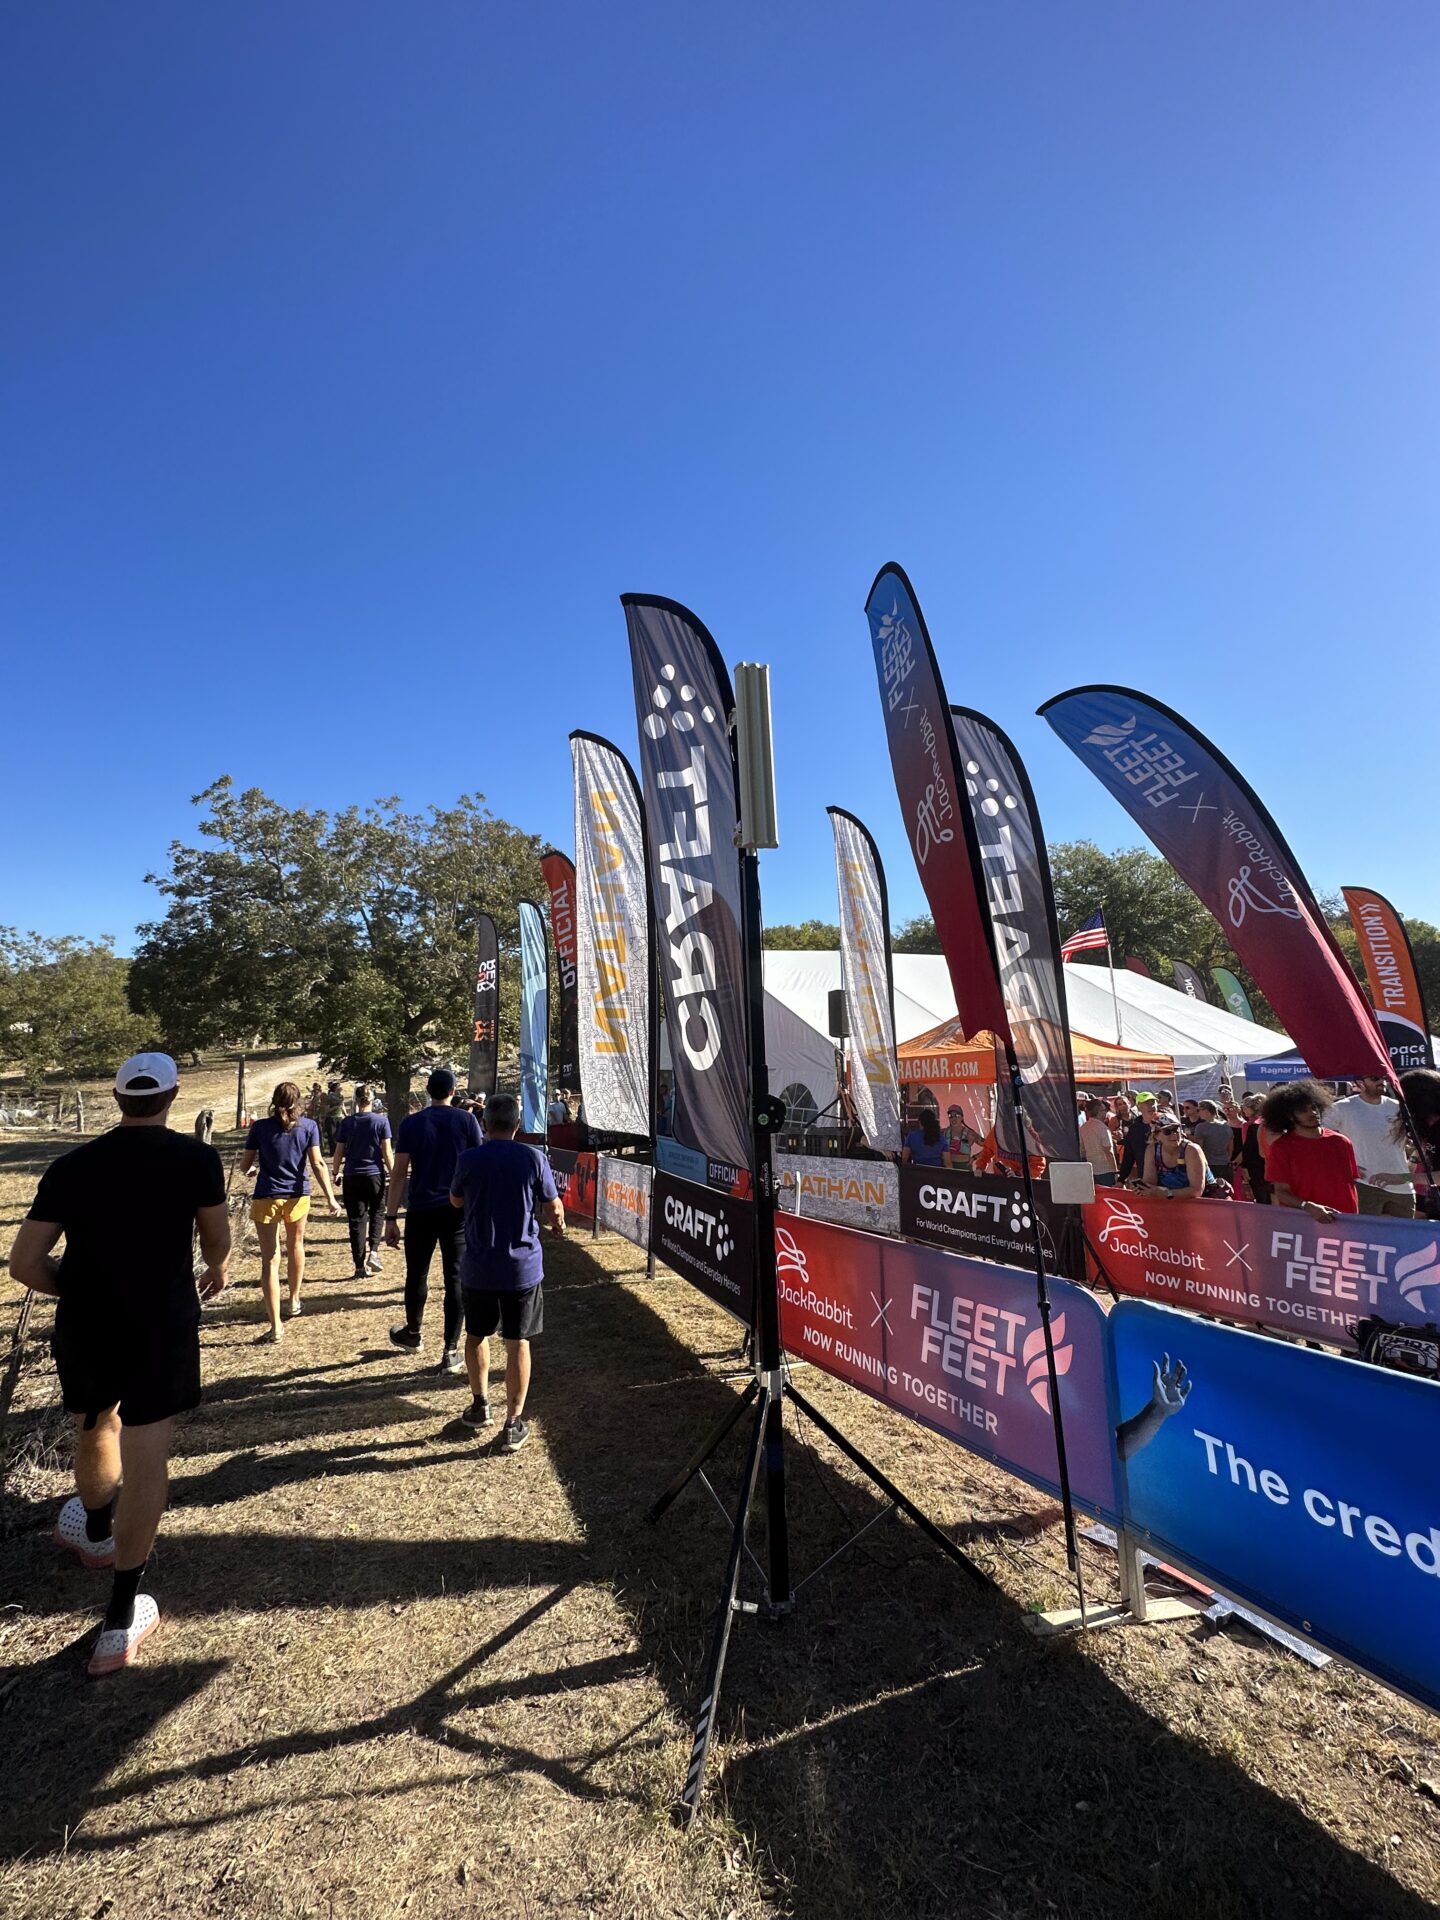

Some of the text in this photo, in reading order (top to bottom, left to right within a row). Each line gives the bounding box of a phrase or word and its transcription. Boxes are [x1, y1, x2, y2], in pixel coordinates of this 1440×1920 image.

[1102, 742, 1180, 809] FLEET
[1130, 732, 1200, 788] FEET
[1221, 808, 1298, 901] JackRabbit
[553, 880, 576, 990] OFFICIAL
[1362, 916, 1406, 1008] TRANSITION
[1260, 1066, 1292, 1075] Ragnar
[1389, 1044, 1425, 1057] pace
[551, 1169, 571, 1191] FICIAL
[708, 1163, 740, 1185] OFFICIAL
[664, 1195, 716, 1247] CRAFT
[919, 1184, 1008, 1223] CRAFT
[916, 1217, 1053, 1259] For World Champions and Everyday Hees
[1109, 1237, 1206, 1271] JackRabbit
[1271, 1230, 1398, 1275] FLEET
[724, 1274, 740, 1296] Heroes
[780, 1280, 854, 1330] JackRabbit
[1145, 1270, 1373, 1327] NOW RUNNING TOGETHE
[1285, 1261, 1388, 1305] FEET
[910, 1283, 1026, 1355] FLEET
[803, 1325, 998, 1435] NOW RUNNING TOGETHER
[921, 1326, 1017, 1397] FEET
[1193, 1428, 1440, 1578] The cred
